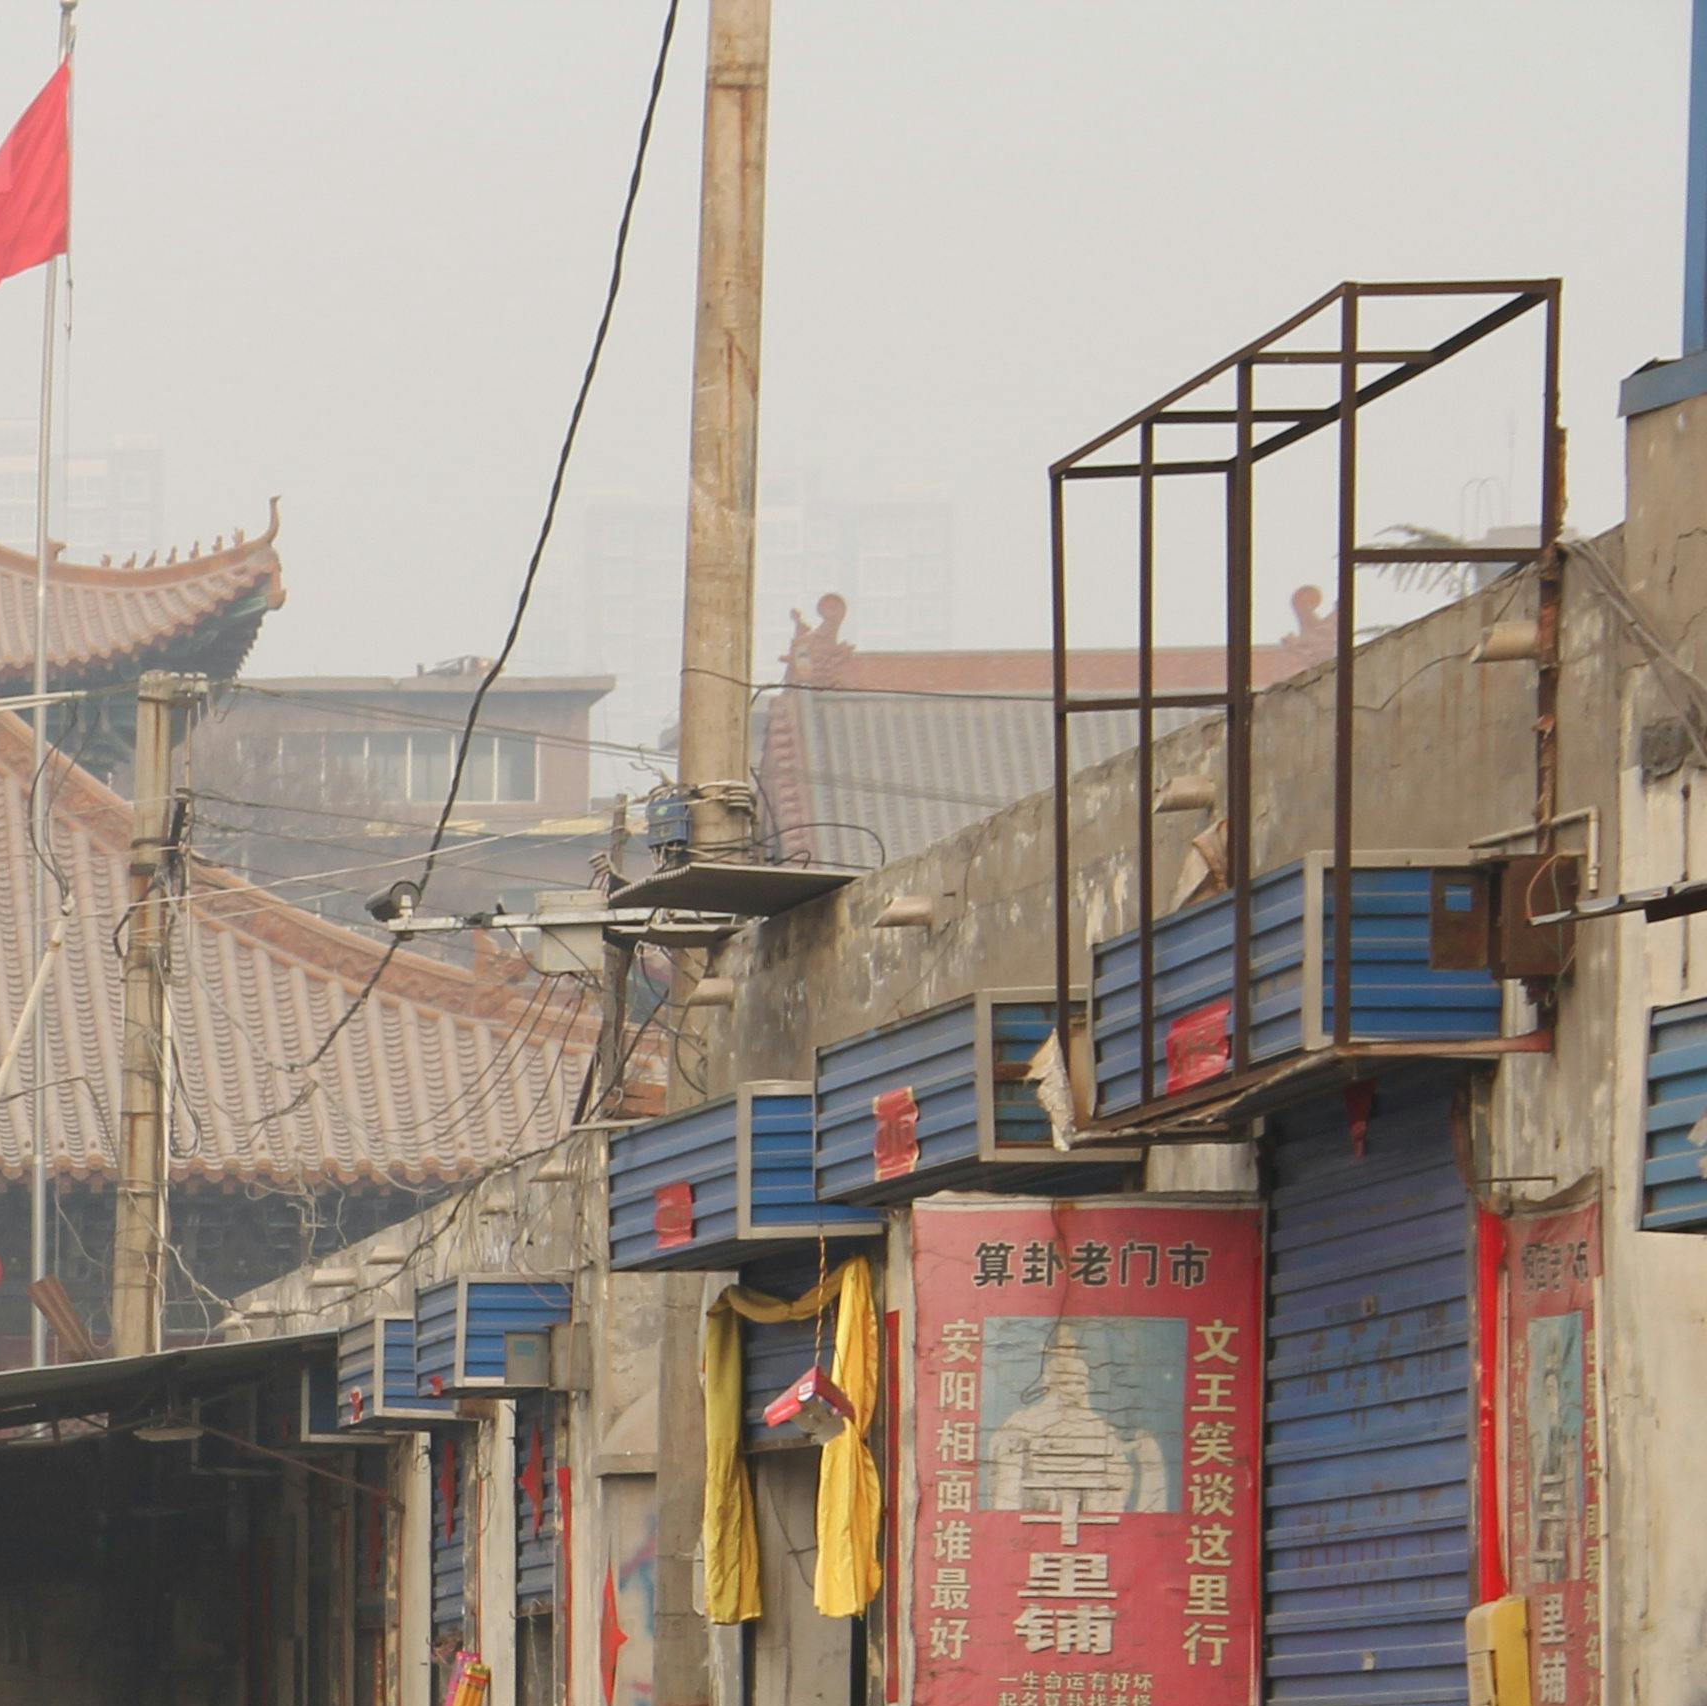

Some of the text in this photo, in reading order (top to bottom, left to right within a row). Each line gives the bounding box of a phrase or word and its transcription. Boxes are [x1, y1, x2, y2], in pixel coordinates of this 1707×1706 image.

[971, 1240, 1213, 1290] 算卦老门市
[928, 1318, 981, 1663] 安阳相面谁最好
[1181, 1318, 1241, 1669] 文王笑谈这里行
[997, 1670, 1154, 1693] 一生命运有好坏
